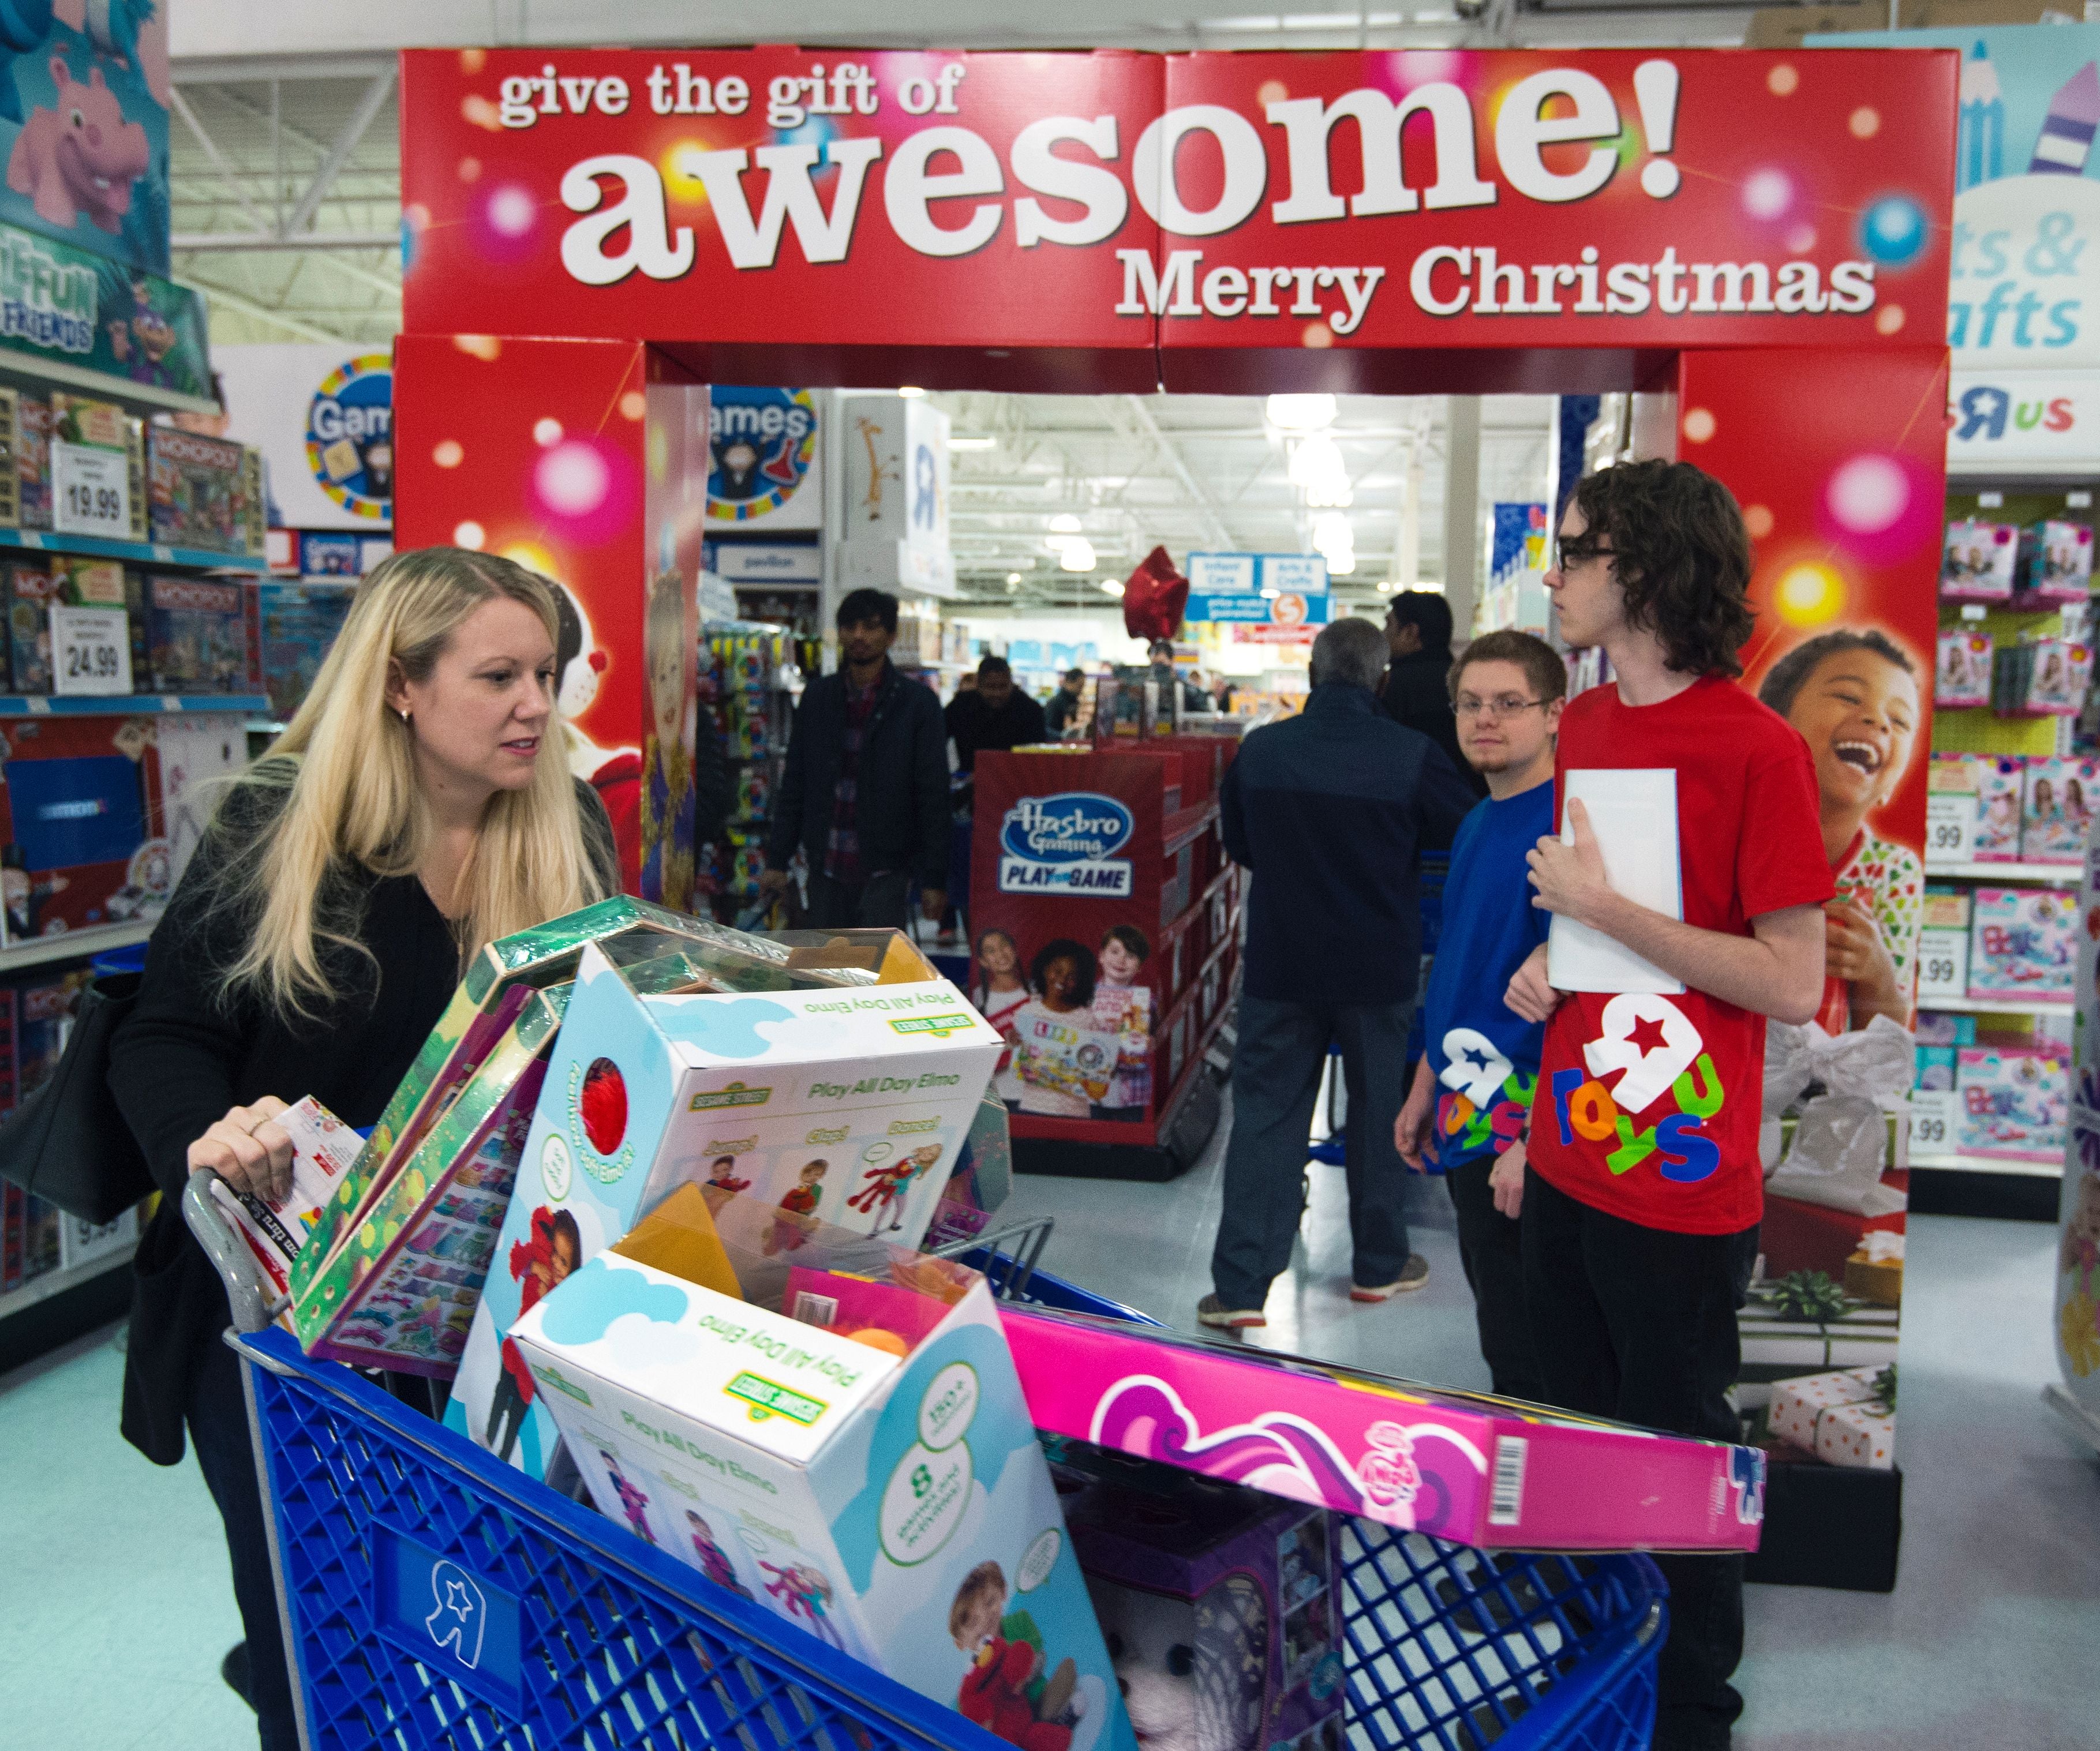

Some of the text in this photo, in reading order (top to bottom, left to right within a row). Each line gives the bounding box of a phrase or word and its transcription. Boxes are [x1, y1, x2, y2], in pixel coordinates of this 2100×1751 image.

[500, 63, 965, 128] give the gift of
[560, 59, 1682, 285] awesome!
[1952, 210, 2087, 279] ts &
[1116, 247, 1876, 335] Merry Christmas
[312, 400, 392, 440] Gam
[710, 404, 809, 438] ames
[68, 483, 120, 520] 19.99
[67, 645, 118, 679] 24.99
[1009, 803, 1121, 838] Hasbro
[1927, 825, 1961, 849] .99
[1028, 830, 1103, 860] Gaming
[1006, 865, 1056, 886] PLAY
[1068, 868, 1126, 890] GAME
[1916, 958, 1955, 983] .99
[804, 993, 956, 1014] Play All Day Elmo
[808, 1072, 961, 1101] Play All Day Elmo
[1908, 1118, 1946, 1142] .99
[698, 1314, 862, 1389] Play All Day Elmo
[620, 1409, 660, 1443] Play
[662, 1428, 686, 1453] All
[689, 1441, 727, 1473] Day
[730, 1460, 778, 1495] Elmo
